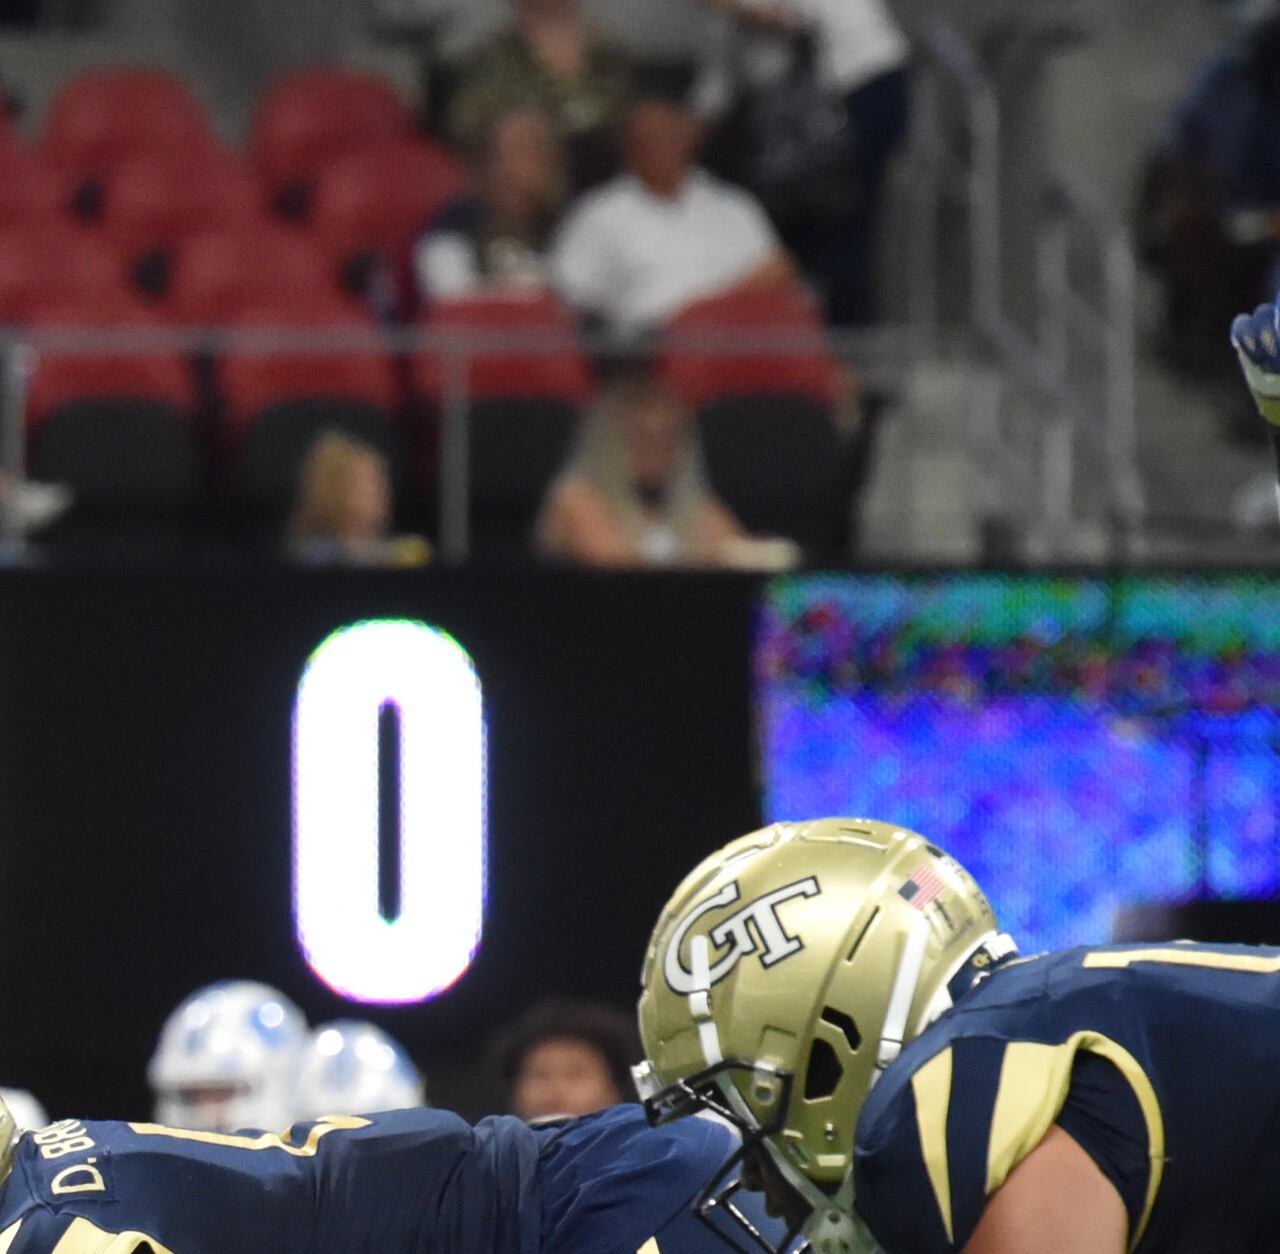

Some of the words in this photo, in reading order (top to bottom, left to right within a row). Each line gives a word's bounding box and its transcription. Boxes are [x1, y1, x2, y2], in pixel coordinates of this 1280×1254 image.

[291, 618, 489, 1005] 0
[664, 875, 822, 997] GT
[33, 1118, 96, 1160] BR
[51, 1157, 106, 1195] D.
